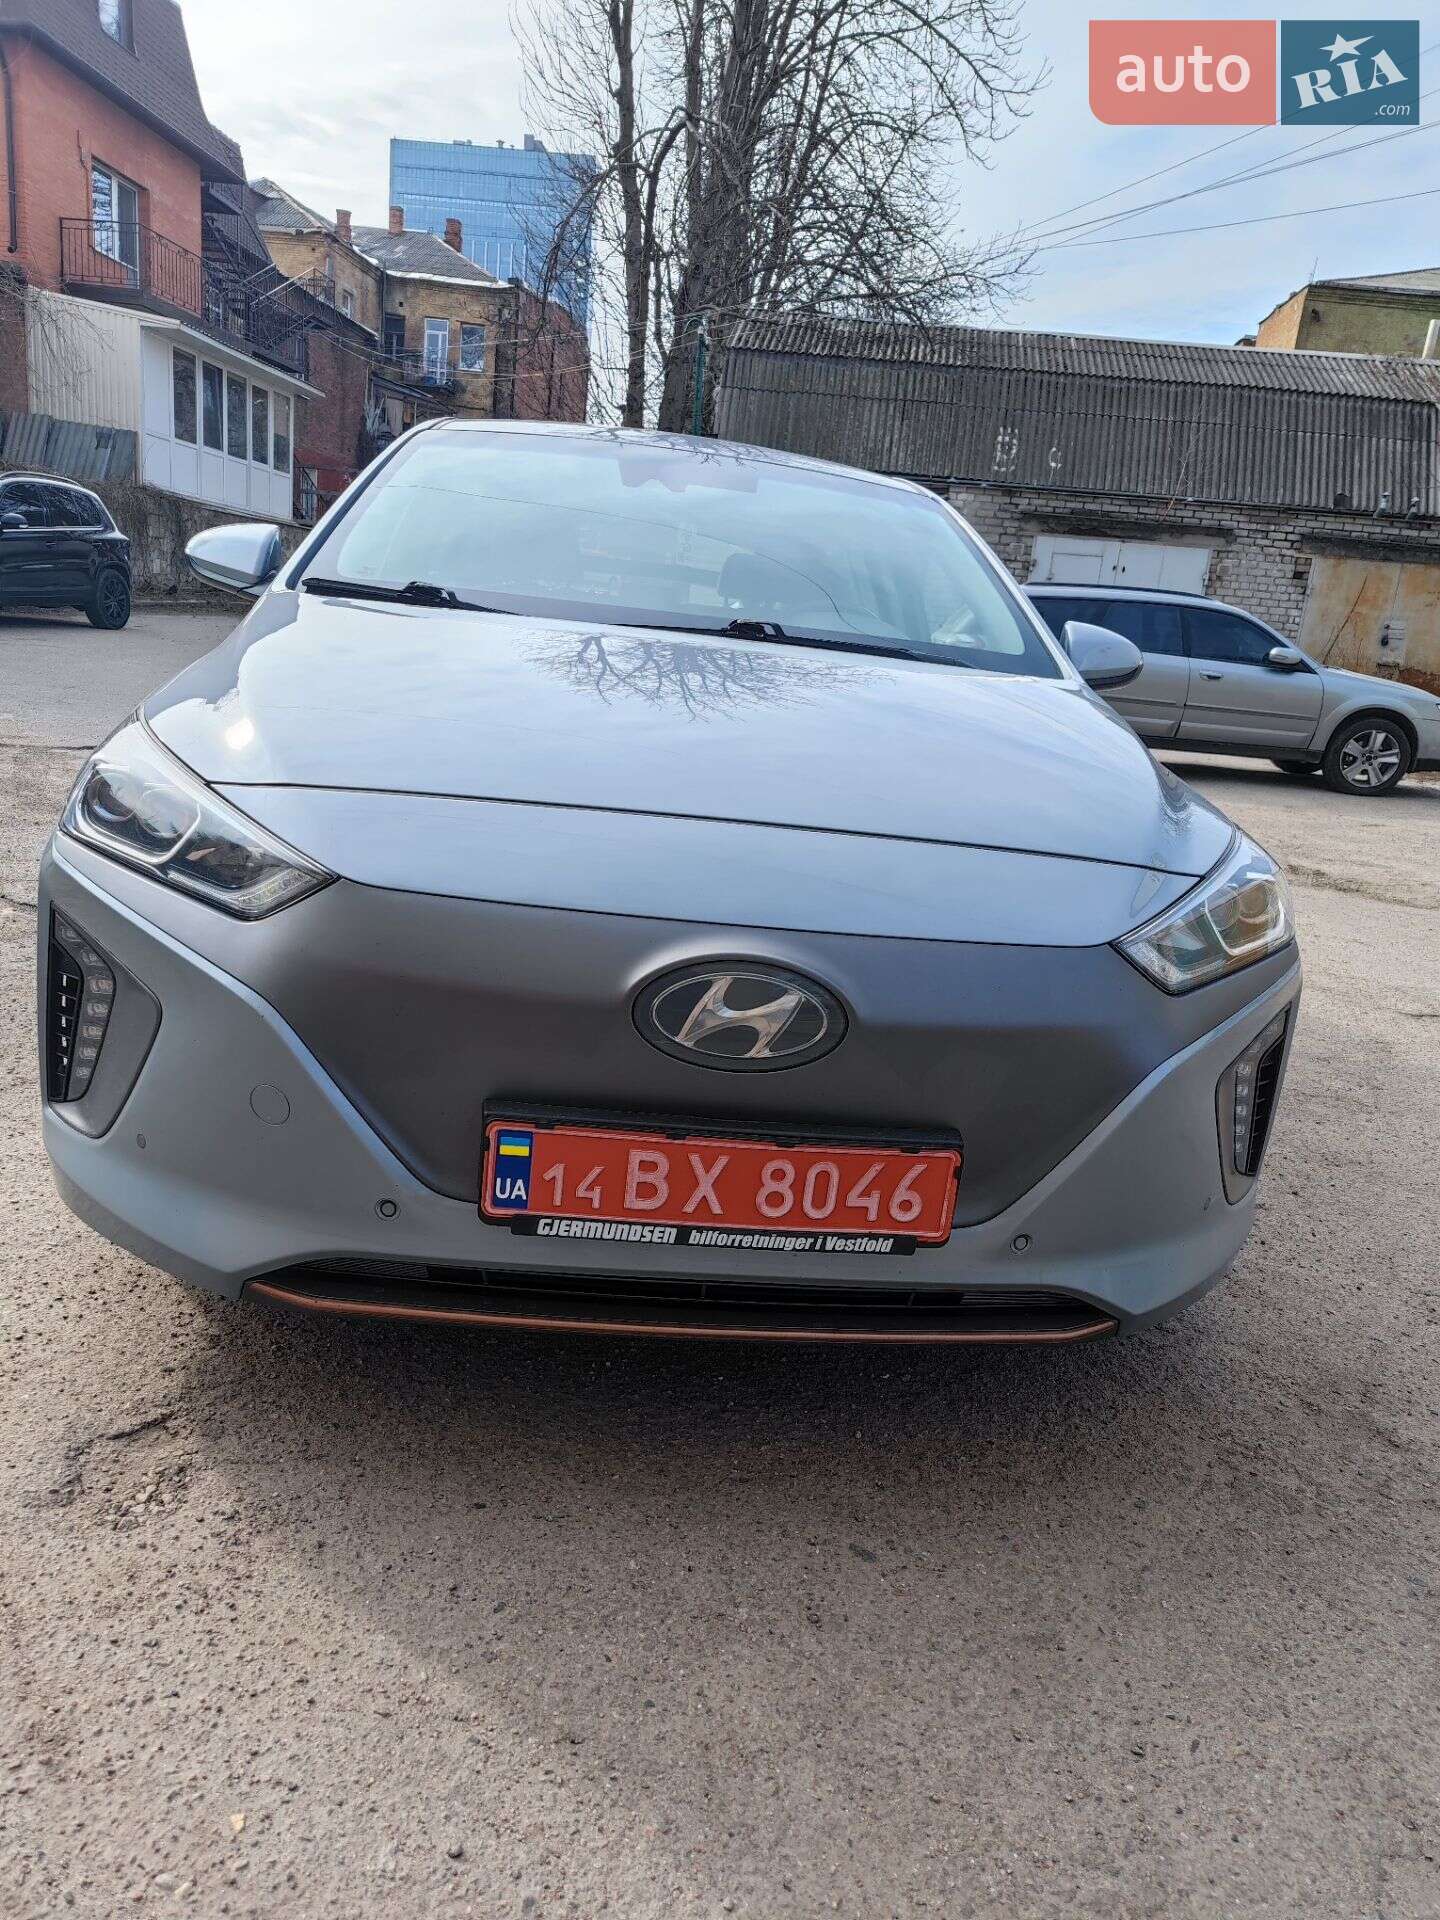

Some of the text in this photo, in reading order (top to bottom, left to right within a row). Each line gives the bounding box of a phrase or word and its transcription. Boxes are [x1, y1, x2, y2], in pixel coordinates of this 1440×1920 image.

[495, 1177, 527, 1200] UA
[542, 1149, 930, 1223] 14 BX 8046
[536, 1218, 895, 1253] GJERMUNDSEN bilforretninger i Vestfold
